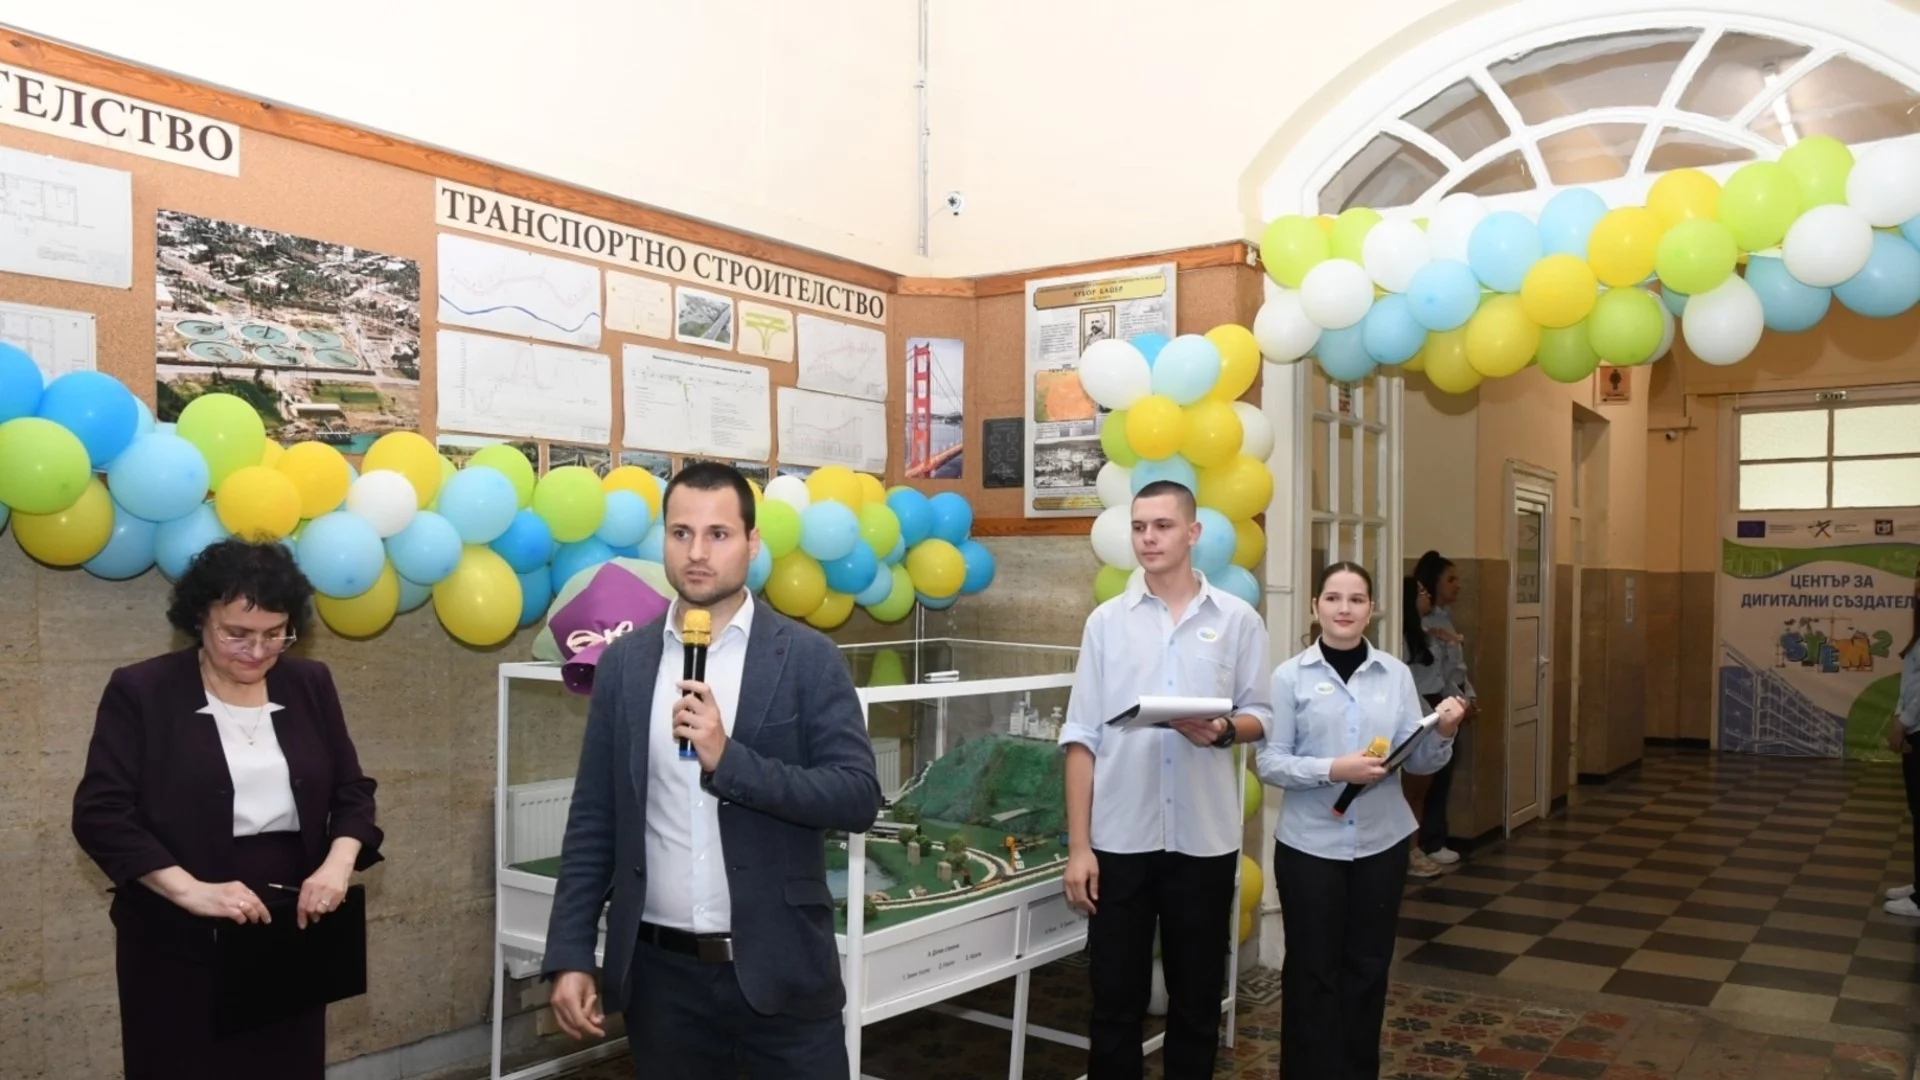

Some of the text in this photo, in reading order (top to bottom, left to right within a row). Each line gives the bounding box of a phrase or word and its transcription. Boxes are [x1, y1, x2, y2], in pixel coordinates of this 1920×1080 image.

[0, 70, 233, 162] ЕЛСТВО
[441, 187, 885, 321] ТРАНСПОРТНО СТРОИТЕЛСТВО
[1741, 594, 1915, 610] ДИГИТАЛНИ СЪЗДАТЕЛ
[1790, 574, 1874, 589] ЦЕНТЪР ЗА
